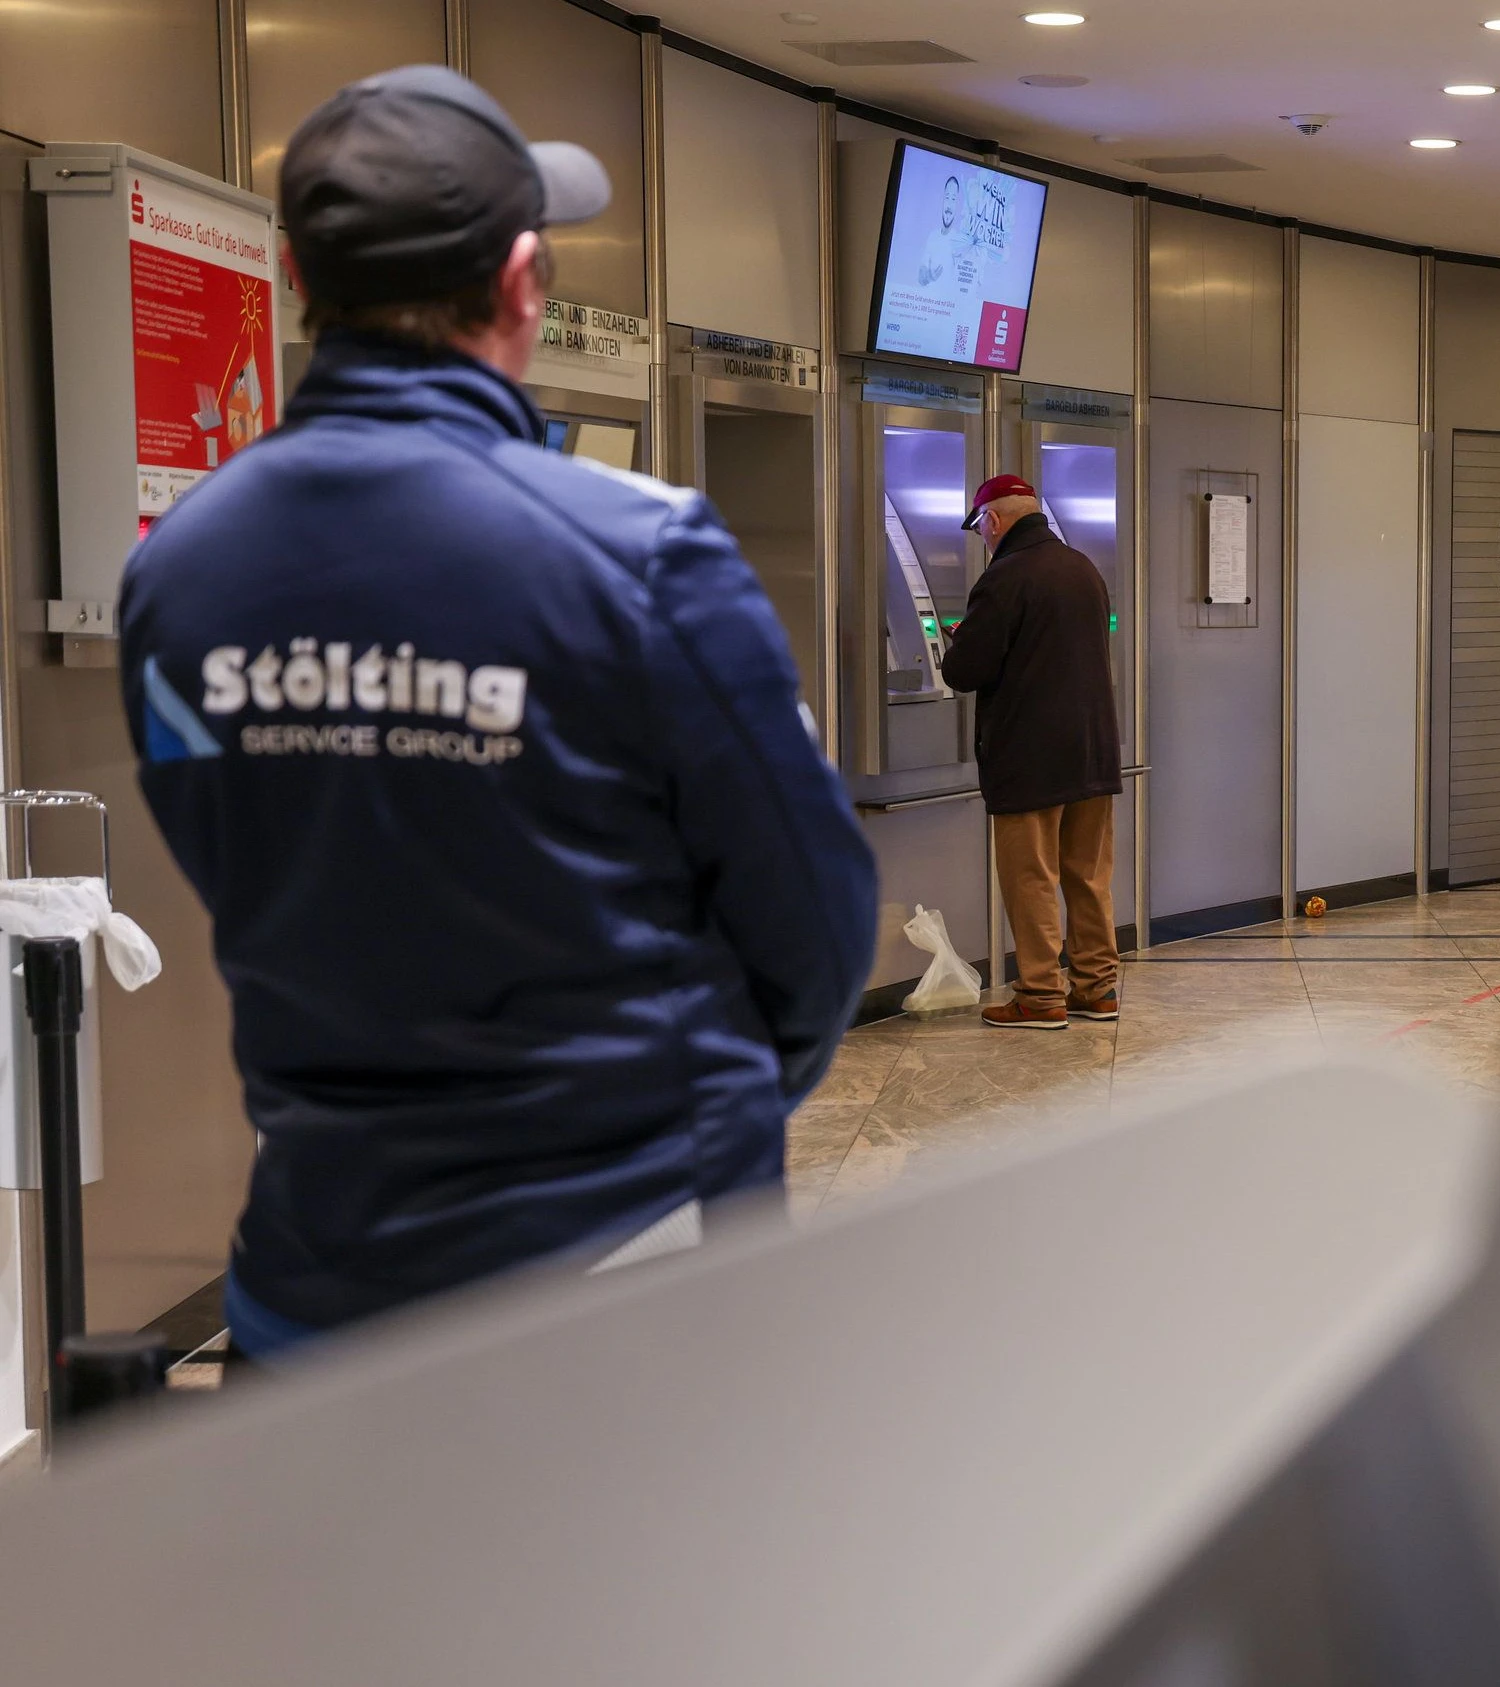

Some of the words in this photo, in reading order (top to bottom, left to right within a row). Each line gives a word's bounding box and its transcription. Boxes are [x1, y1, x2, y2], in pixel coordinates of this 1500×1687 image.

[149, 207, 195, 241] Sparkasse.
[196, 223, 211, 247] Gut
[211, 227, 224, 249] für
[224, 232, 237, 254] die
[238, 237, 268, 265] Umwelt.
[569, 305, 587, 326] UND
[592, 309, 640, 336] EINZAHLEN
[542, 325, 562, 347] VON
[566, 330, 621, 357] BANKNOTEN
[706, 333, 744, 354] ABHEBEN
[746, 341, 763, 358] UND
[764, 343, 806, 365] EINZAHLEN
[724, 358, 741, 375] VON
[742, 361, 791, 383] BANKNOTEN
[888, 377, 924, 396] BARGELD
[925, 383, 959, 400] ABHEBEN
[1045, 398, 1078, 415] BARGELD
[1078, 403, 1110, 418] ABHEBEN
[202, 637, 528, 734] Stölting
[241, 725, 380, 757] SERVICE
[386, 727, 524, 766] GROUP
